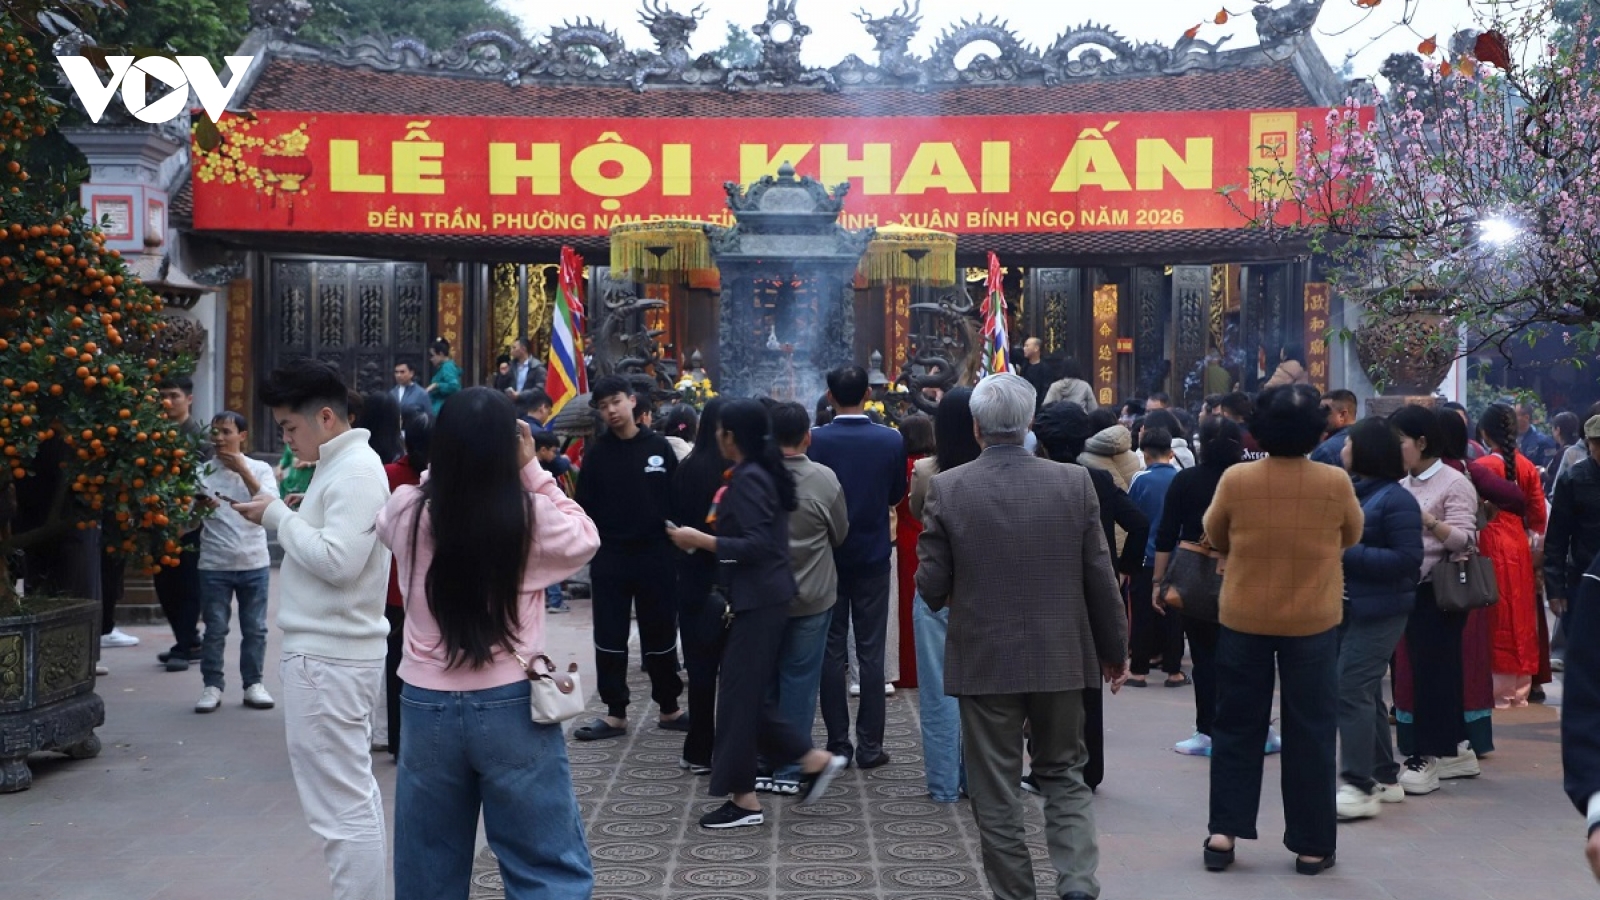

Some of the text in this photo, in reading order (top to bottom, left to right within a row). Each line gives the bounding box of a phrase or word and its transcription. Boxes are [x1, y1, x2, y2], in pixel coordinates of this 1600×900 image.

[329, 119, 1214, 211] LỄ HỘI KHAI ẤN
[367, 205, 414, 228] ĐỀN
[420, 206, 487, 232] TRẦN,
[492, 208, 586, 230] PHƯỜNG
[835, 209, 878, 229] ÌNH
[899, 207, 959, 229] XUÂN
[966, 207, 1019, 228] BÍNH
[1026, 210, 1076, 231] NGỌ
[1080, 206, 1129, 226] NĂM
[1135, 208, 1185, 226] 2026
